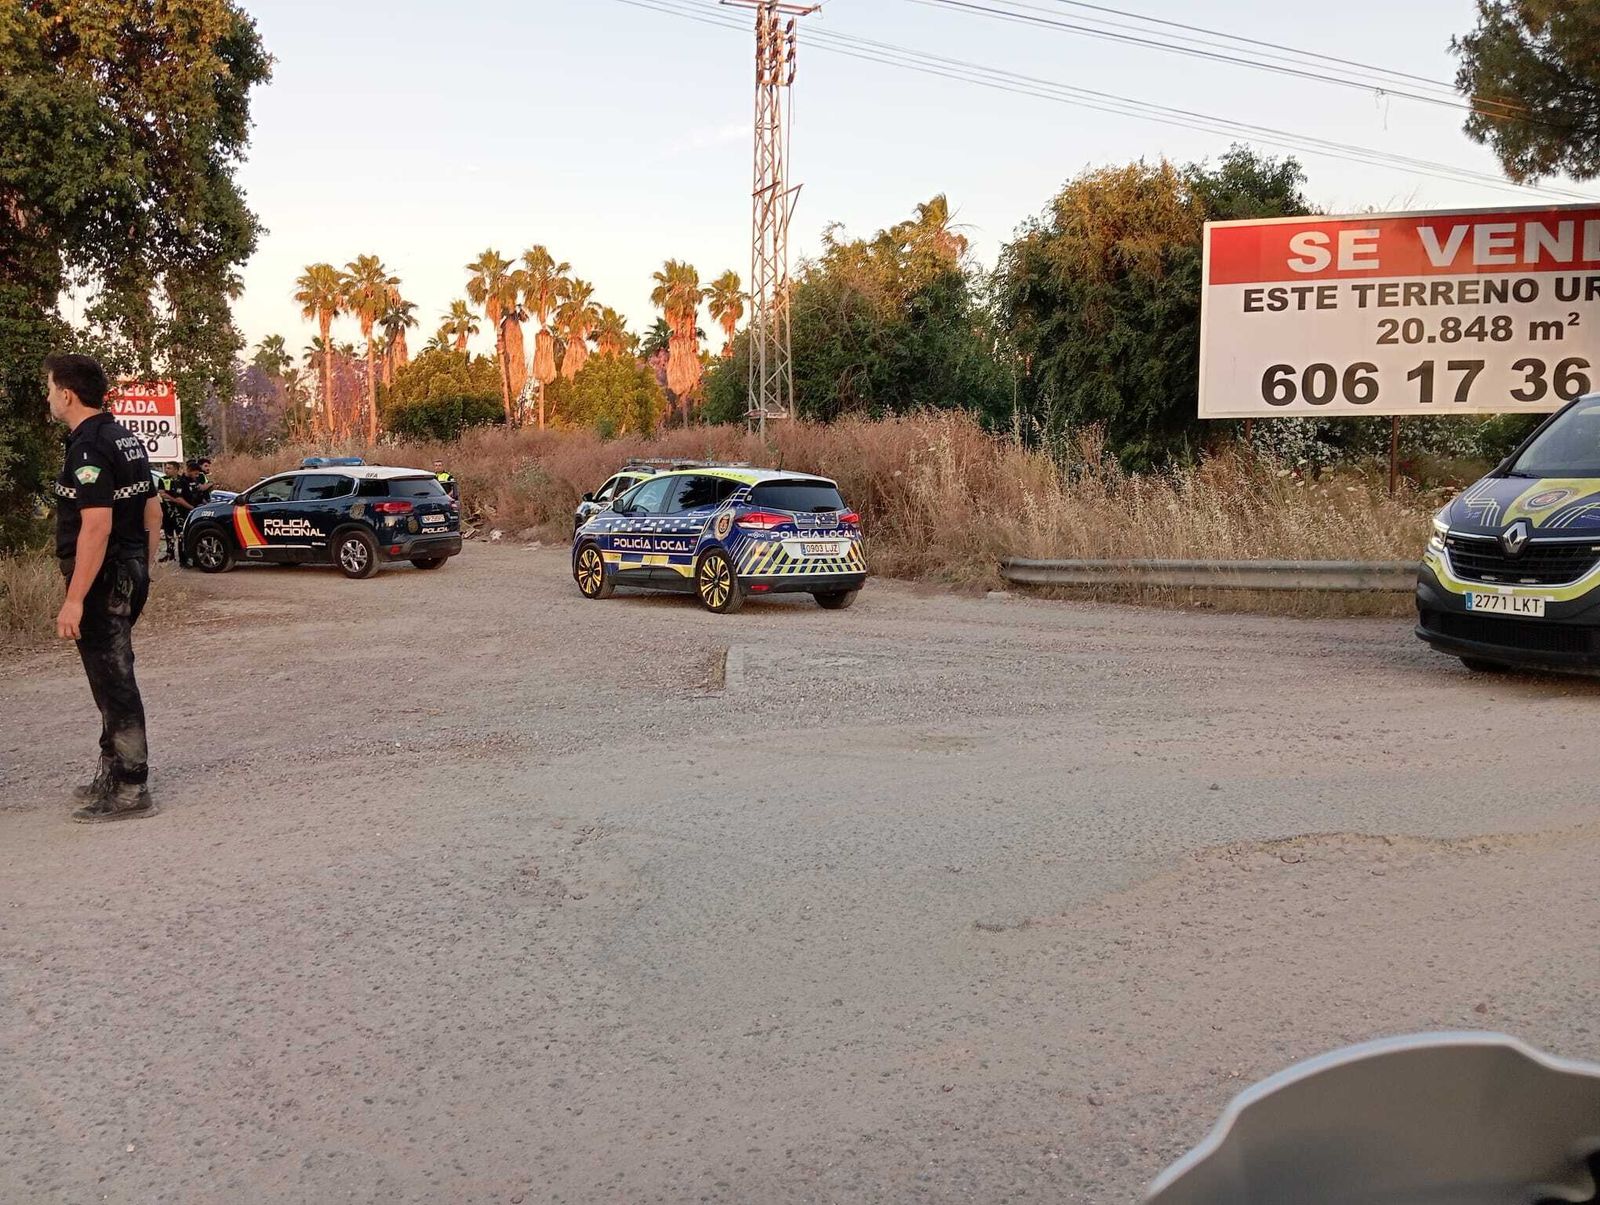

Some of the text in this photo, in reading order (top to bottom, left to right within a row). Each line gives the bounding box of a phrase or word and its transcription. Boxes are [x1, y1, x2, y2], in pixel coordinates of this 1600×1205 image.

[1287, 228, 1380, 273] SE
[1244, 286, 1338, 312] ESTE
[1352, 278, 1540, 308] TERRENO
[1376, 312, 1580, 345] 20.848 m²
[1261, 357, 1592, 406] 606 17 36
[118, 420, 169, 433] IBIDO
[264, 518, 311, 528] POLICÍA
[264, 528, 326, 537] NACIONAL
[771, 528, 855, 539] POLICÍA LOCAL
[613, 537, 689, 550] POLICÍA LOCAL
[806, 544, 824, 553] 0903
[1475, 594, 1540, 613] 2771 LKT
